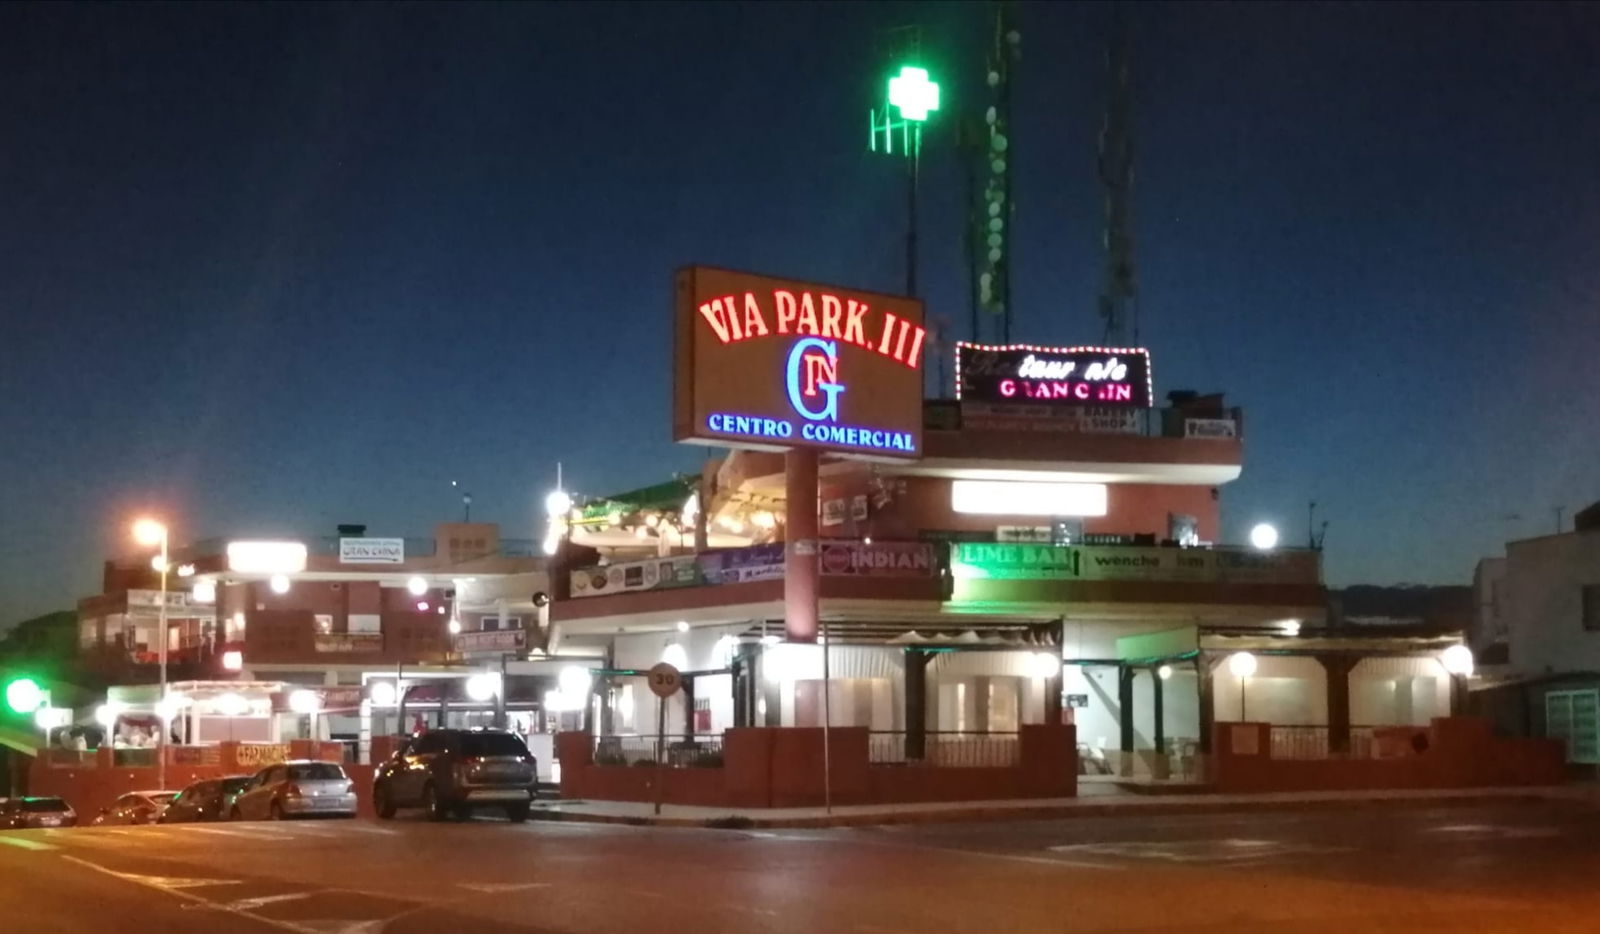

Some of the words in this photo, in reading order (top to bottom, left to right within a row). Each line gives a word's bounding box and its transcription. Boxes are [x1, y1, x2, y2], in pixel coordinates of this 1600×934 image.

[700, 292, 769, 344] VIA
[877, 312, 926, 369] III
[708, 413, 793, 437] CENTRO
[802, 424, 915, 450] COMERCIAL
[851, 551, 929, 568] INDIAN
[964, 546, 1017, 563] LIME
[1023, 546, 1070, 564] BAR
[656, 673, 674, 686] 30
